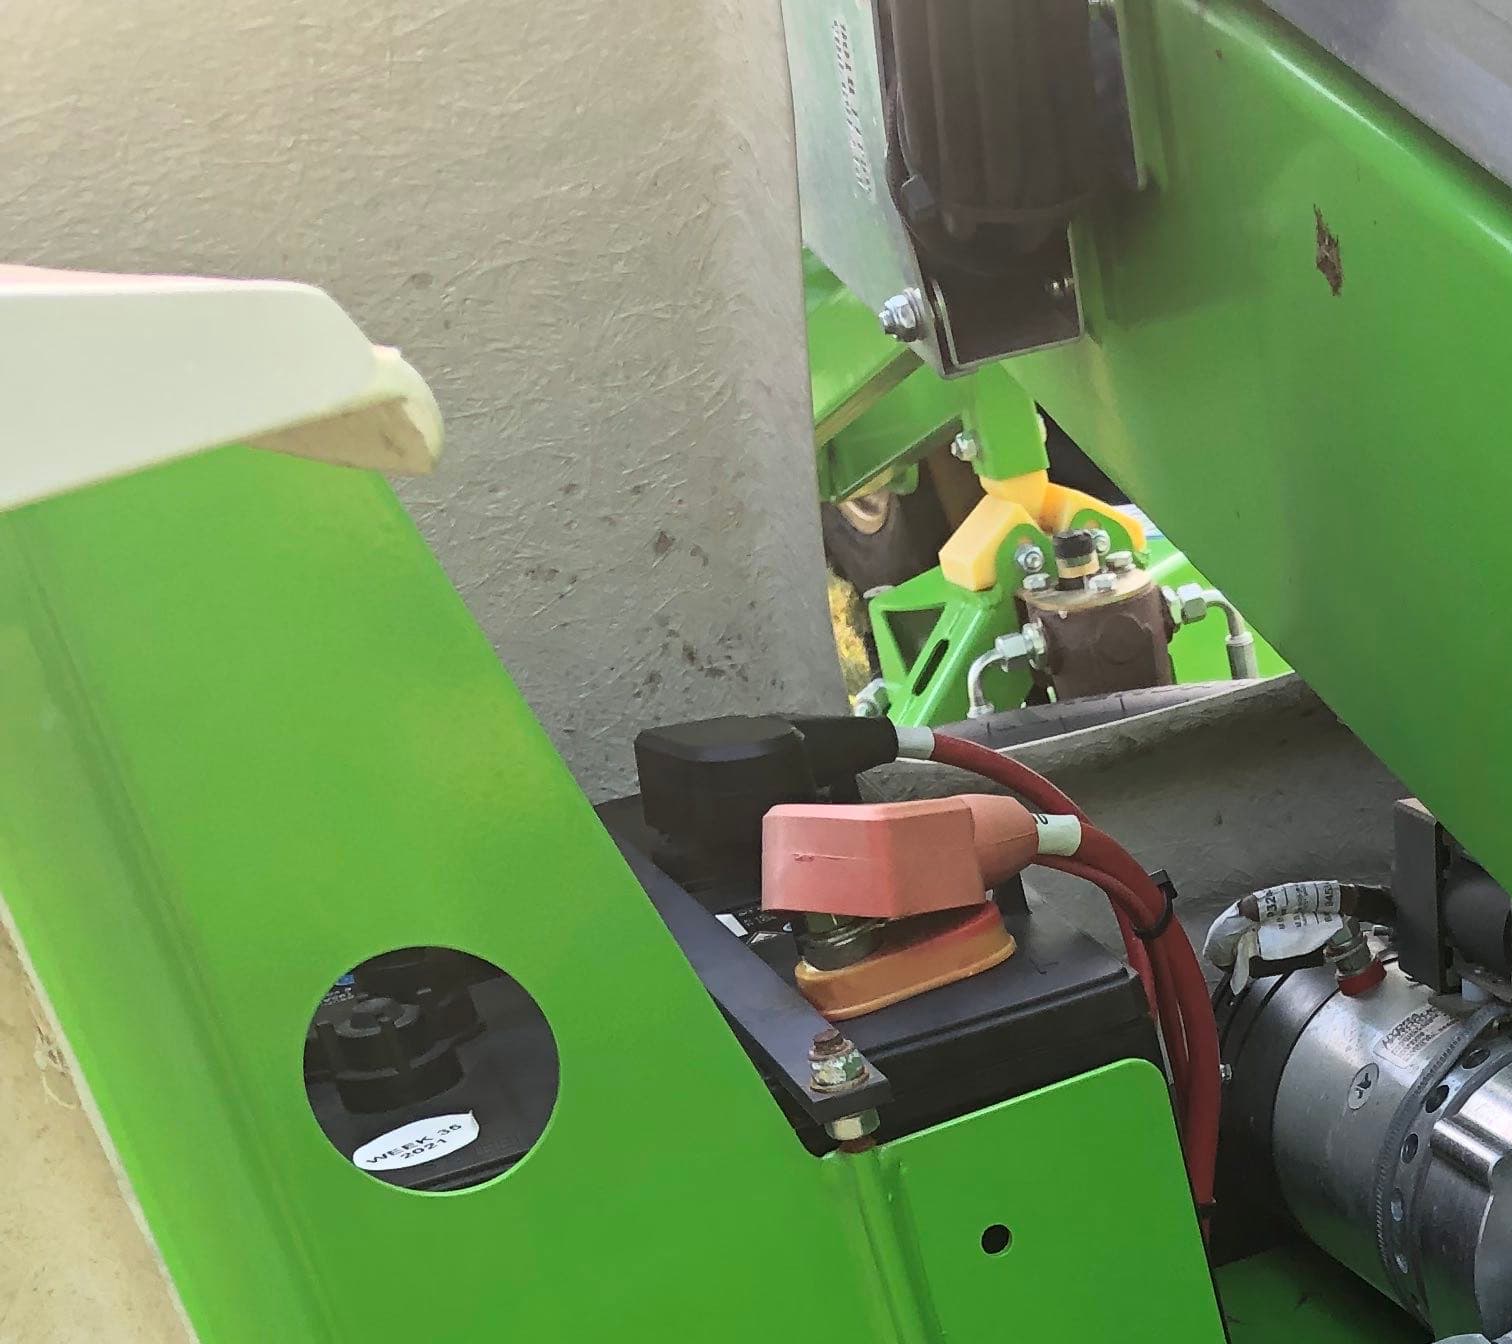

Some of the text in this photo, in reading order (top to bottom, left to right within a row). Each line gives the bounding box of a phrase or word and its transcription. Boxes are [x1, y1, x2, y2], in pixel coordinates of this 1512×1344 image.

[366, 1124, 462, 1163] WEEK 36
[400, 1139, 447, 1159] 2021
